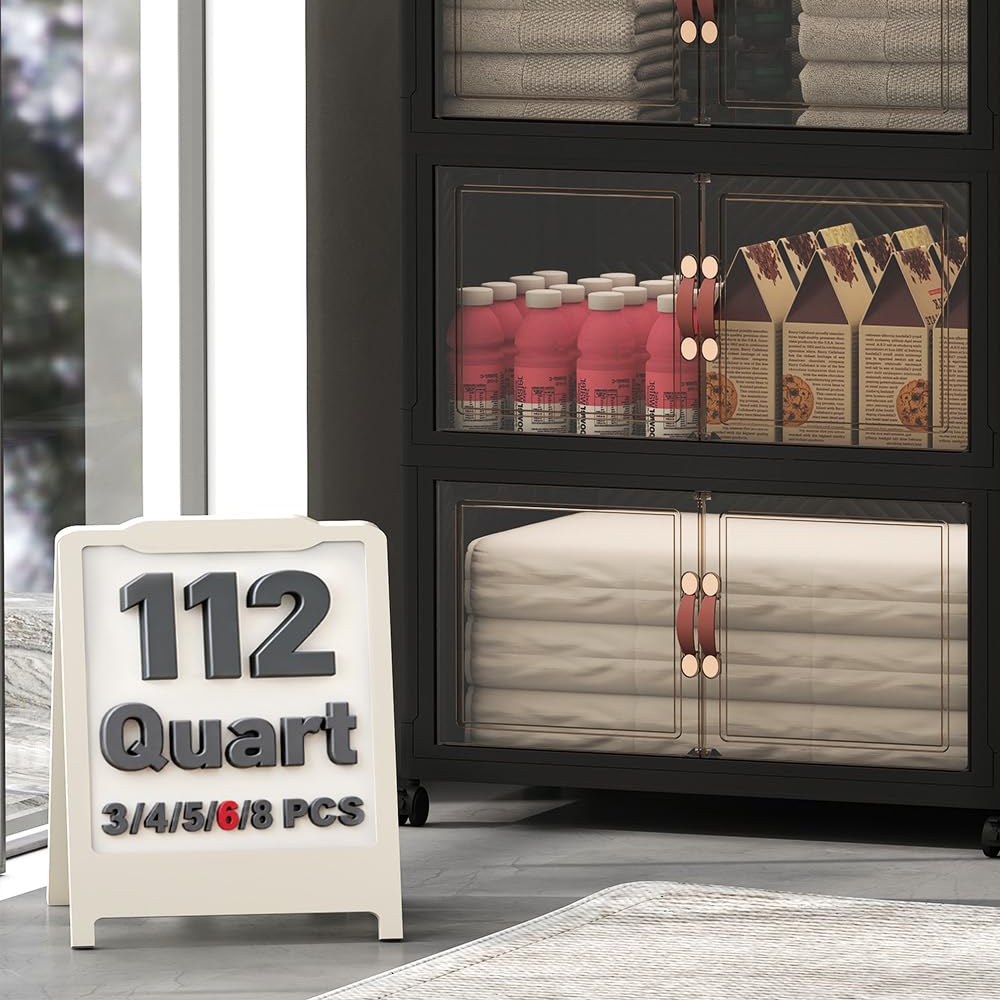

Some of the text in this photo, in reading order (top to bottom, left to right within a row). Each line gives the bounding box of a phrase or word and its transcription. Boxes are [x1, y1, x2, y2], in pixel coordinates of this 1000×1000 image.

[119, 570, 336, 681] 112
[100, 701, 358, 773] Quart
[101, 796, 365, 836] 3/4/5/6/8 PCS
